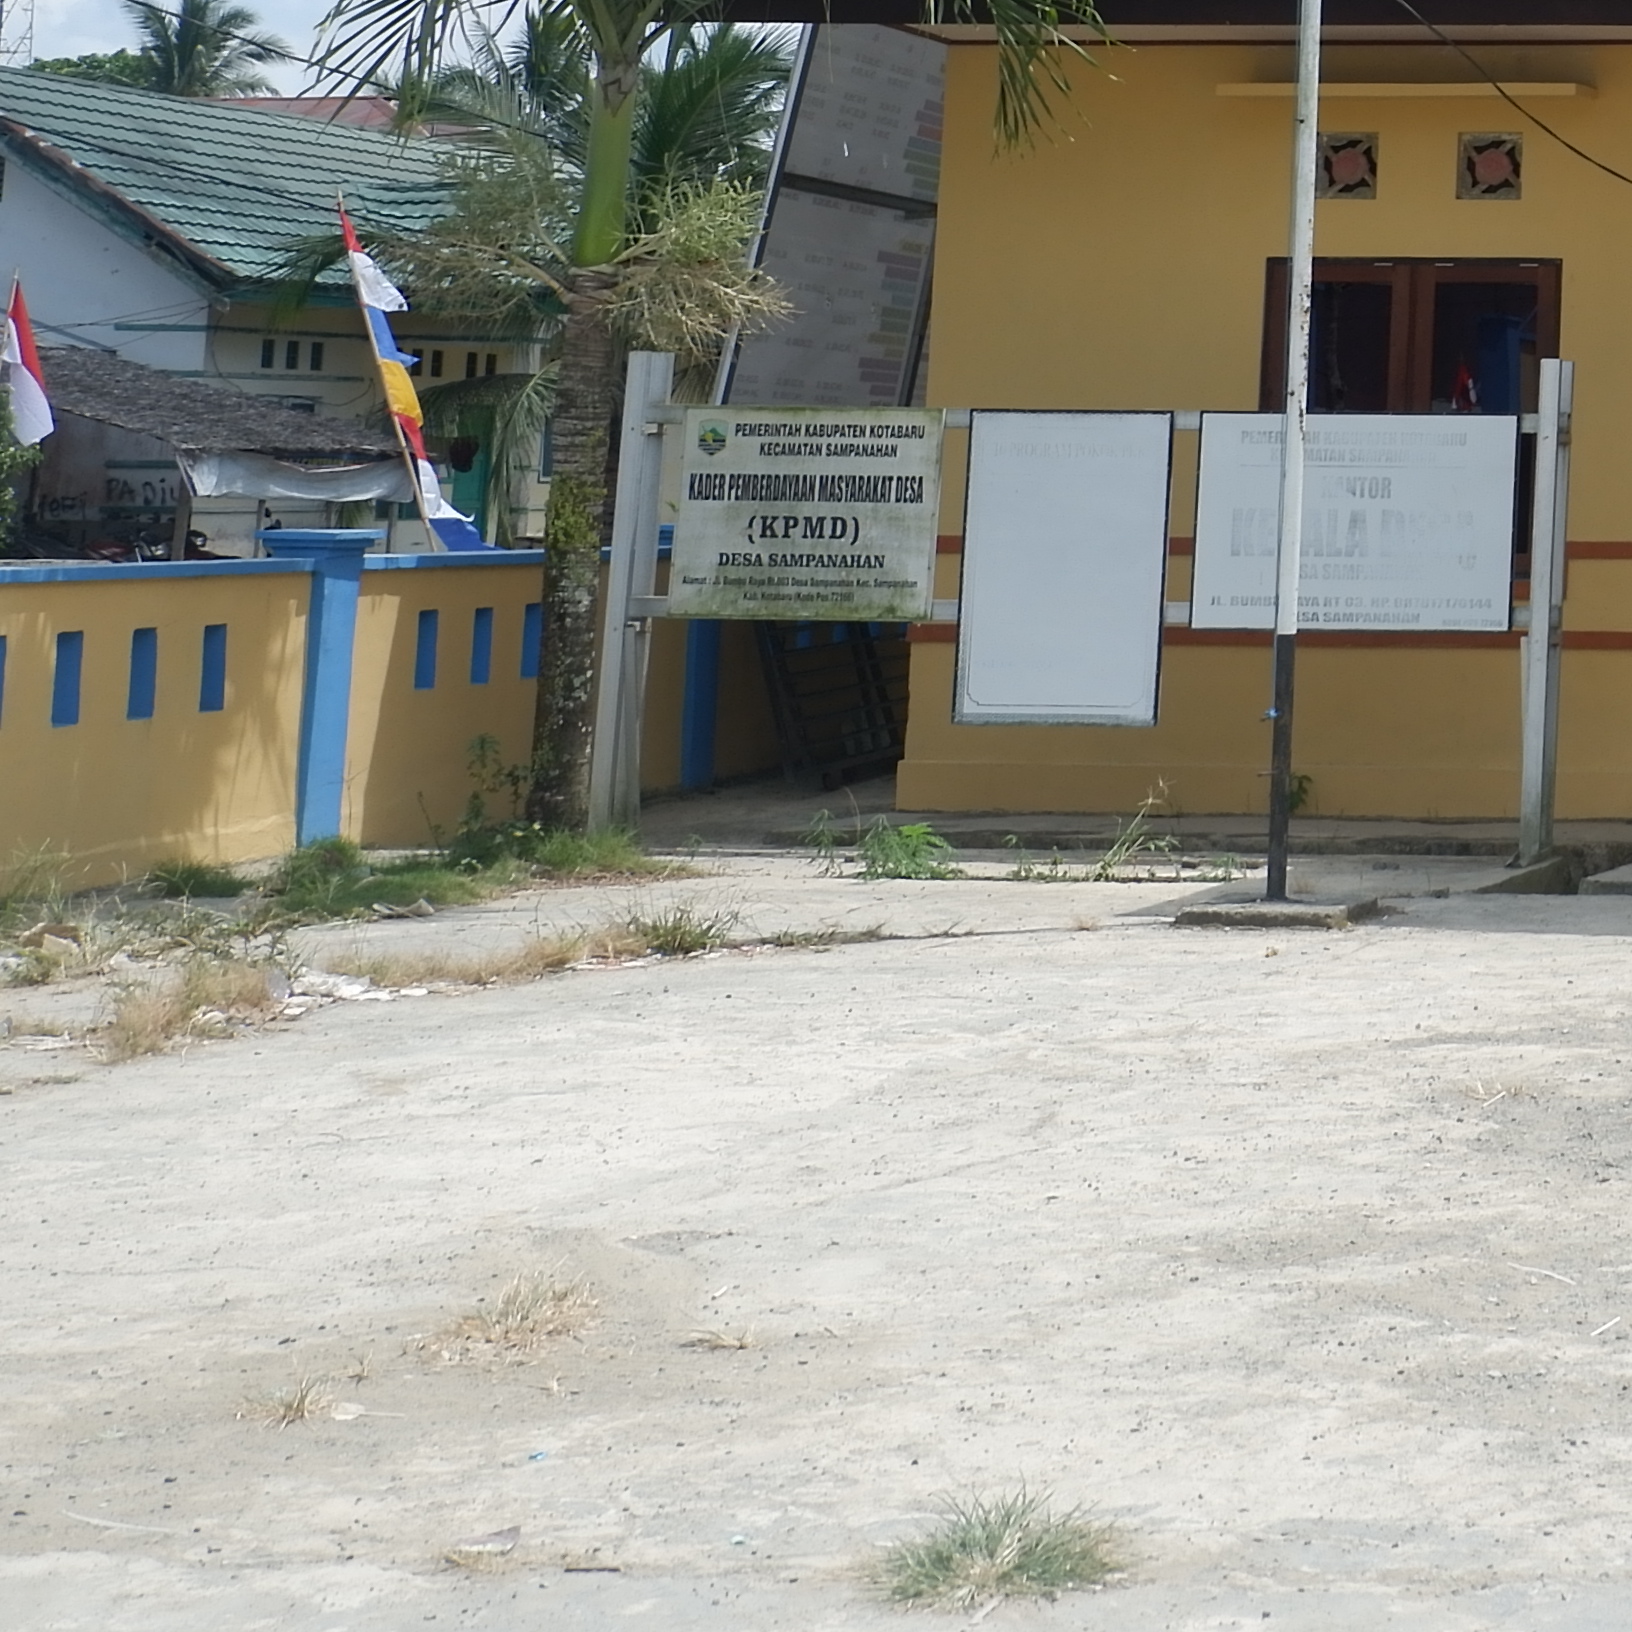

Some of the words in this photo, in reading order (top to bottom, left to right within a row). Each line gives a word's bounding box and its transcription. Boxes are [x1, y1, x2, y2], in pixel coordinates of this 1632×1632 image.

[735, 422, 801, 438] PEMERINTAH
[804, 424, 866, 439] KABUPATEN
[869, 425, 925, 440] KOTABARU
[1241, 430, 1321, 445] PEMERAH
[759, 442, 822, 457] KECAMATAN
[826, 443, 898, 458] SAMPANAHAN
[688, 473, 725, 501] KADER
[727, 473, 816, 502] PEMBERDAYAAN
[818, 475, 894, 503] MASYARAKAT
[895, 476, 924, 504] DESA
[747, 515, 860, 546] (KPMD)
[1230, 508, 1368, 558] KEALA
[718, 552, 763, 567] DESA
[768, 553, 885, 569] SAMPANAHAN
[1297, 595, 1320, 607] AYA
[1323, 611, 1420, 624] SAMPANAHAN
